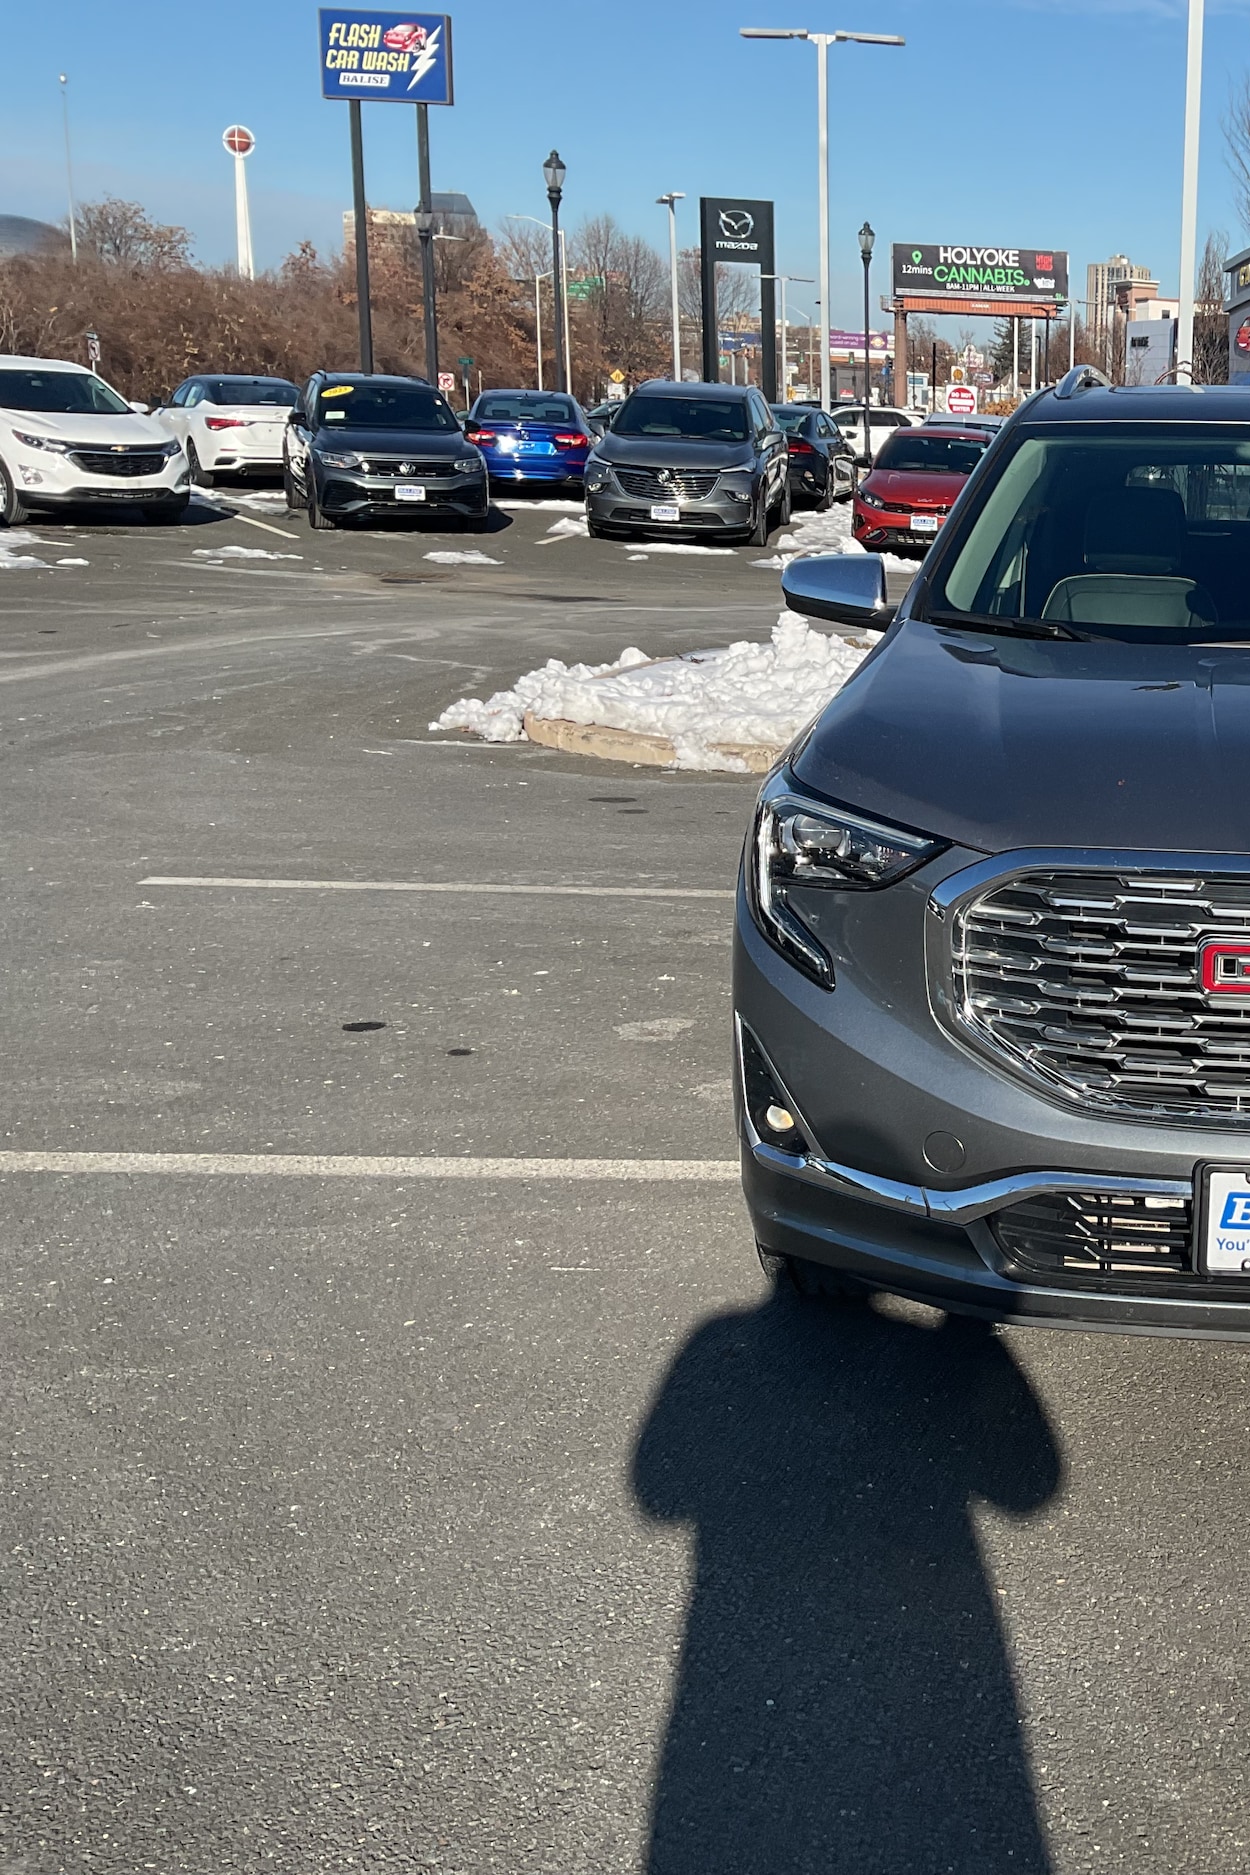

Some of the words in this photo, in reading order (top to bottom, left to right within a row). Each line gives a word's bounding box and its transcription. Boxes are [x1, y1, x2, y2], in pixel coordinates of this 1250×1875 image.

[329, 22, 381, 48] FLASH
[326, 49, 359, 69] CAR
[362, 51, 410, 72] WASH
[342, 74, 387, 85] BALISE
[939, 247, 1019, 267] HOLYOKE
[902, 264, 932, 275] 12mins
[946, 283, 980, 292] 8AM-11PM
[984, 284, 1015, 293] ALL-WEEK
